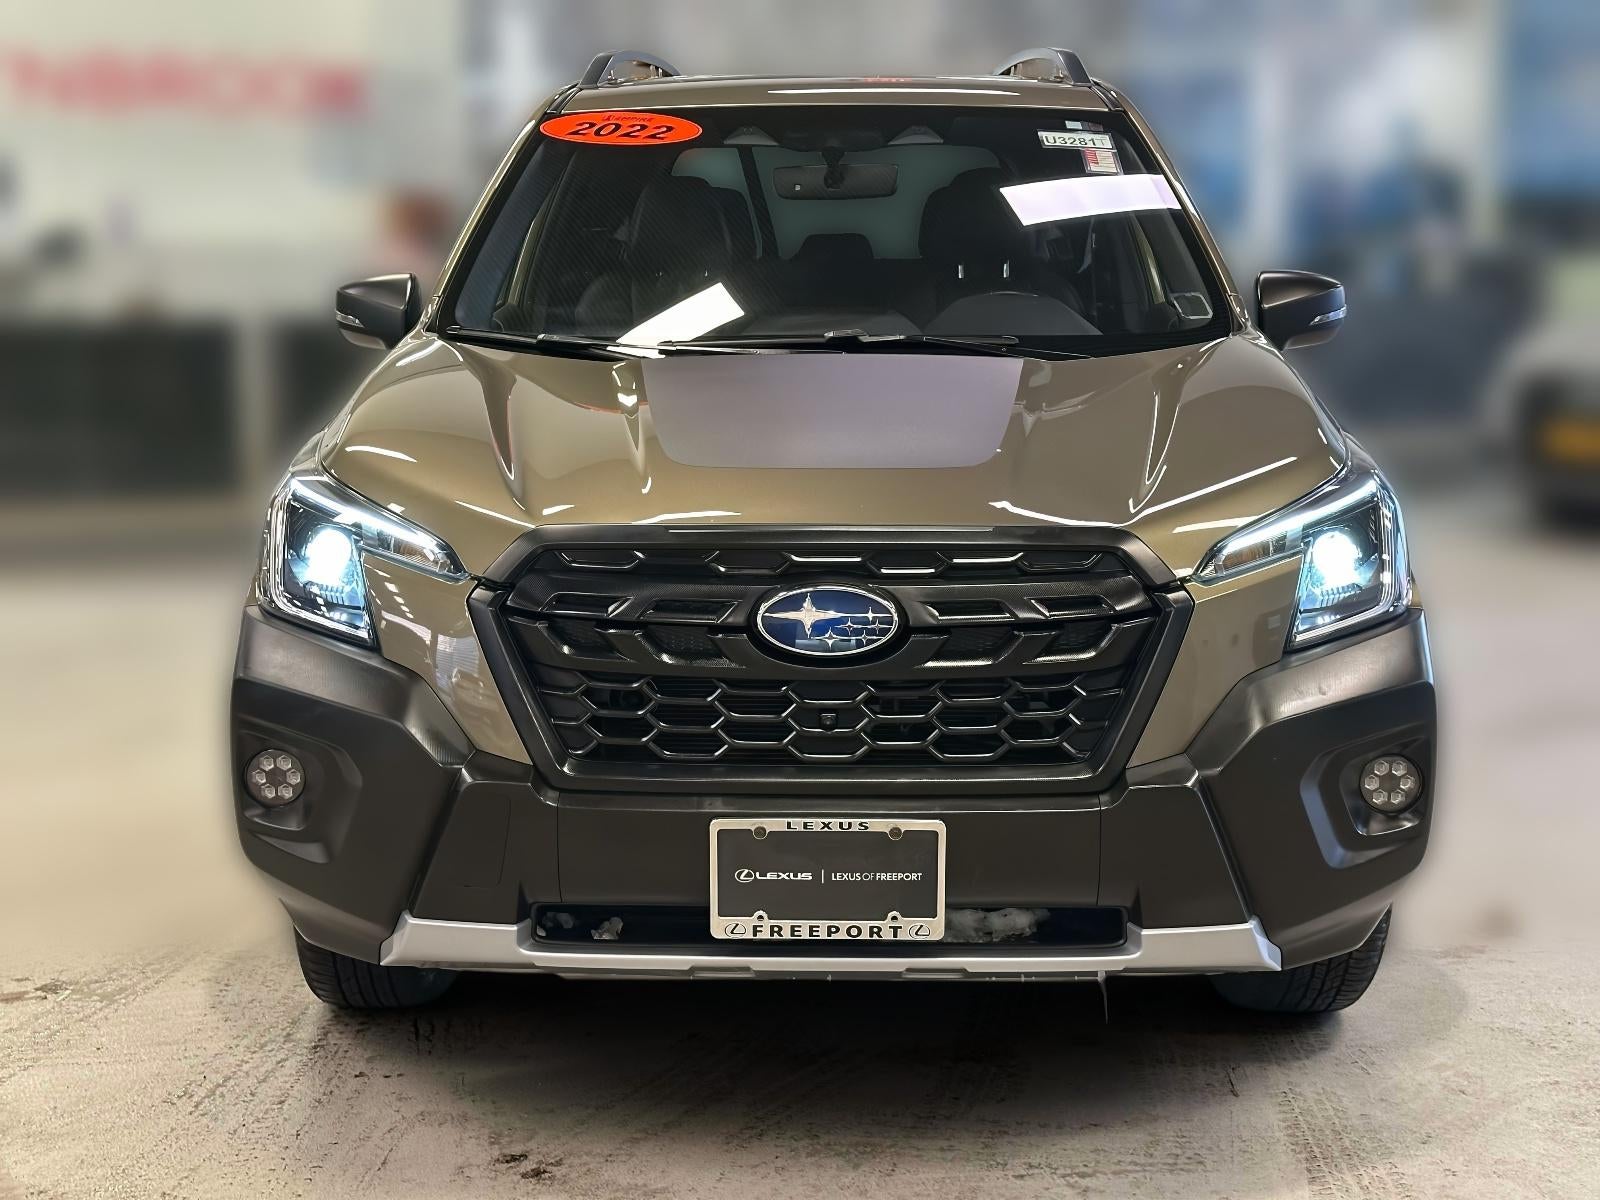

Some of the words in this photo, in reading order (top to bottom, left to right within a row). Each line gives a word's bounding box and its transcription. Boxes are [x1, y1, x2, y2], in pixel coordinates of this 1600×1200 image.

[565, 121, 674, 140] 2022
[786, 821, 870, 831] LEXUS
[755, 871, 813, 880] LEXUS
[831, 872, 861, 881] LEXUS
[862, 872, 876, 881] OF
[876, 872, 923, 881] FREEPORT
[752, 924, 903, 939] FREEPORT
